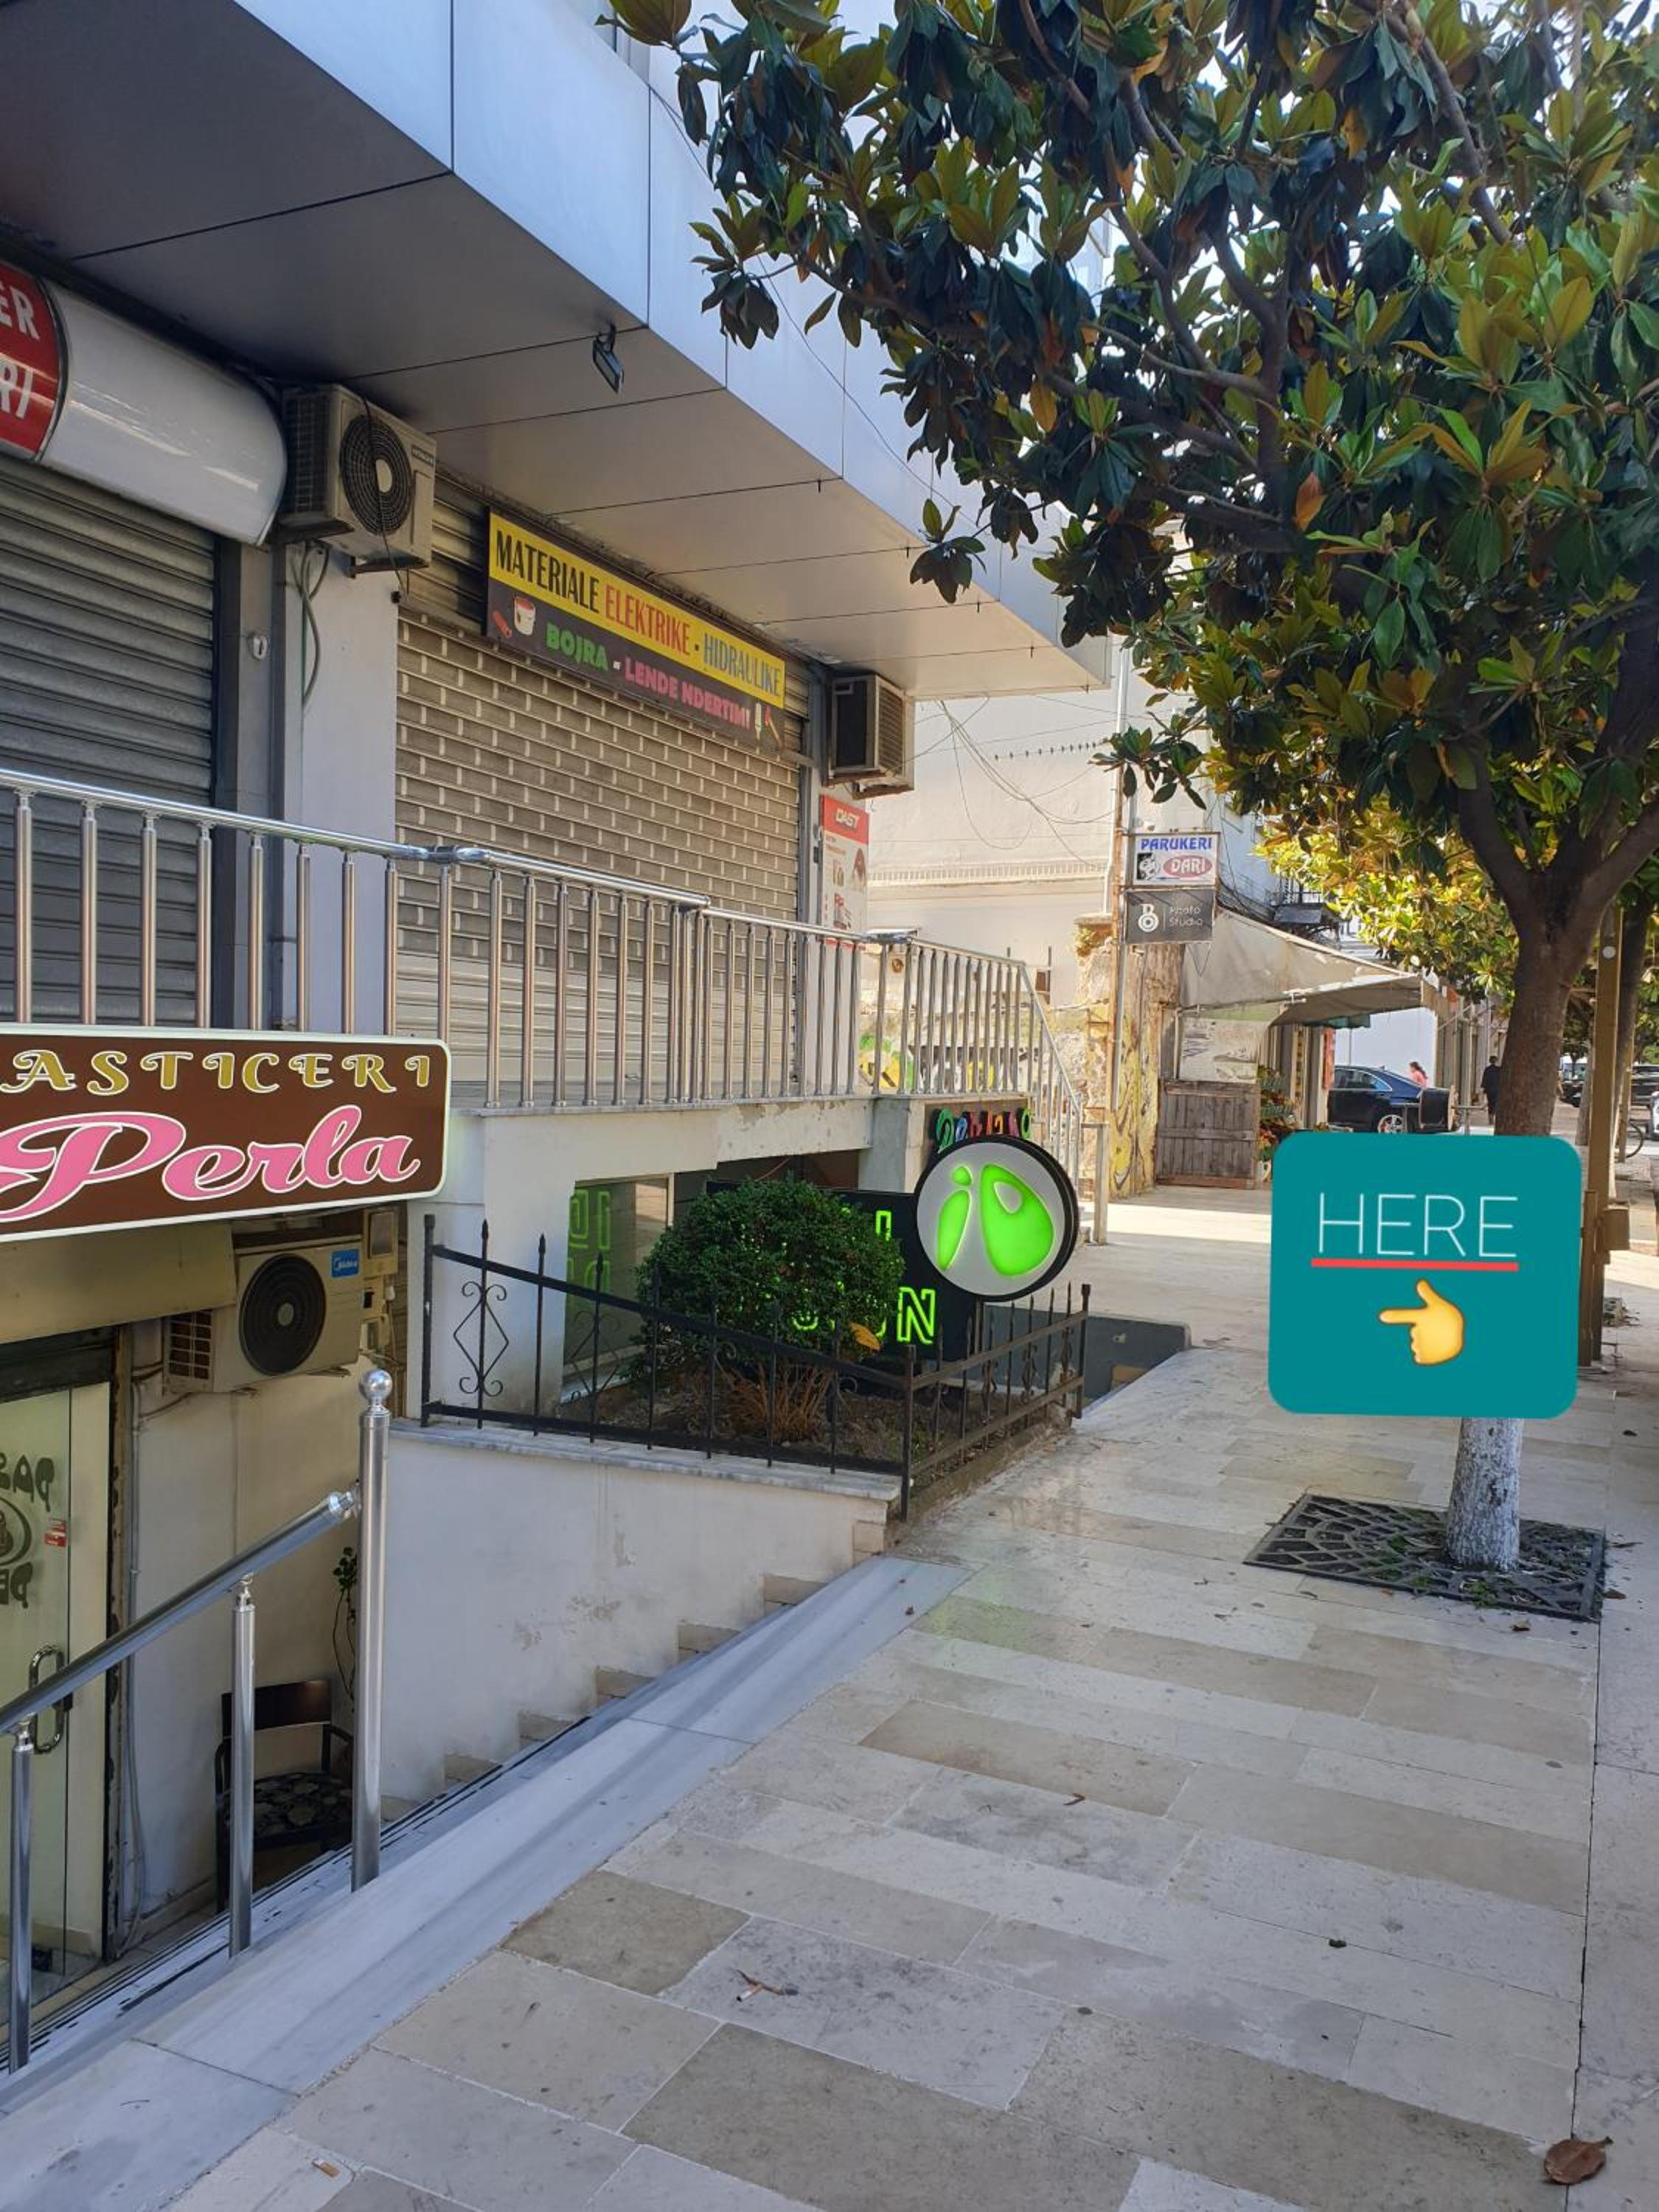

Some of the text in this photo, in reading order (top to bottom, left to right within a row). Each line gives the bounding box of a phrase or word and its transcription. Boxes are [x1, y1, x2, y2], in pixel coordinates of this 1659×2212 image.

[496, 530, 782, 697] MATERIALE ELEKTRIKE HIDRAULIKE
[546, 622, 608, 669] BOJRA
[625, 656, 678, 699] LENDE
[1141, 837, 1212, 850] PARUKERI
[1171, 858, 1206, 874] DARI
[1169, 918, 1203, 928] Studio
[0, 1105, 421, 1222] Perla
